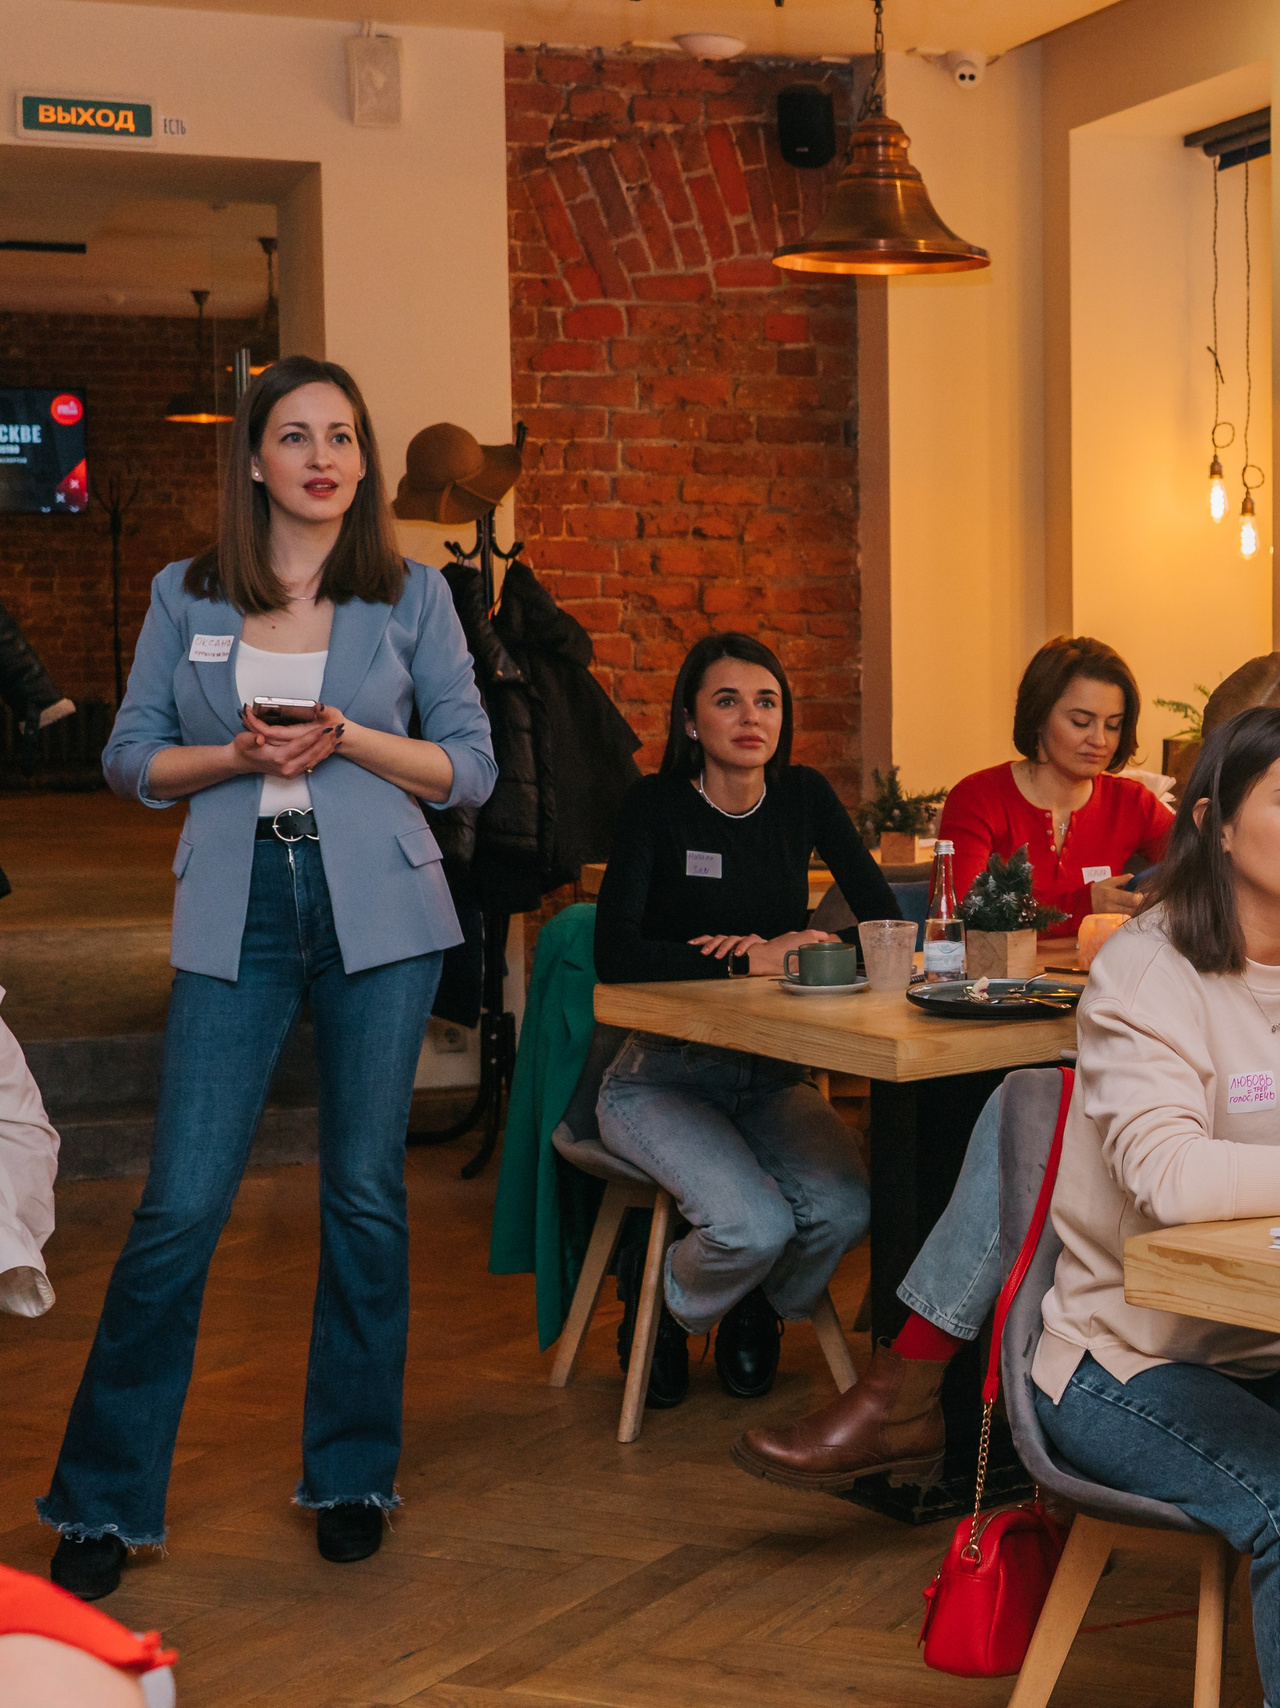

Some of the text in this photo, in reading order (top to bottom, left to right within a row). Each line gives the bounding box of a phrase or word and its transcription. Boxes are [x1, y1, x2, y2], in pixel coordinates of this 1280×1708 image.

[38, 104, 136, 133] ВЫХОД
[163, 118, 187, 135] ЕСТЬ
[1230, 1074, 1274, 1090] ЛЮБОВЬ
